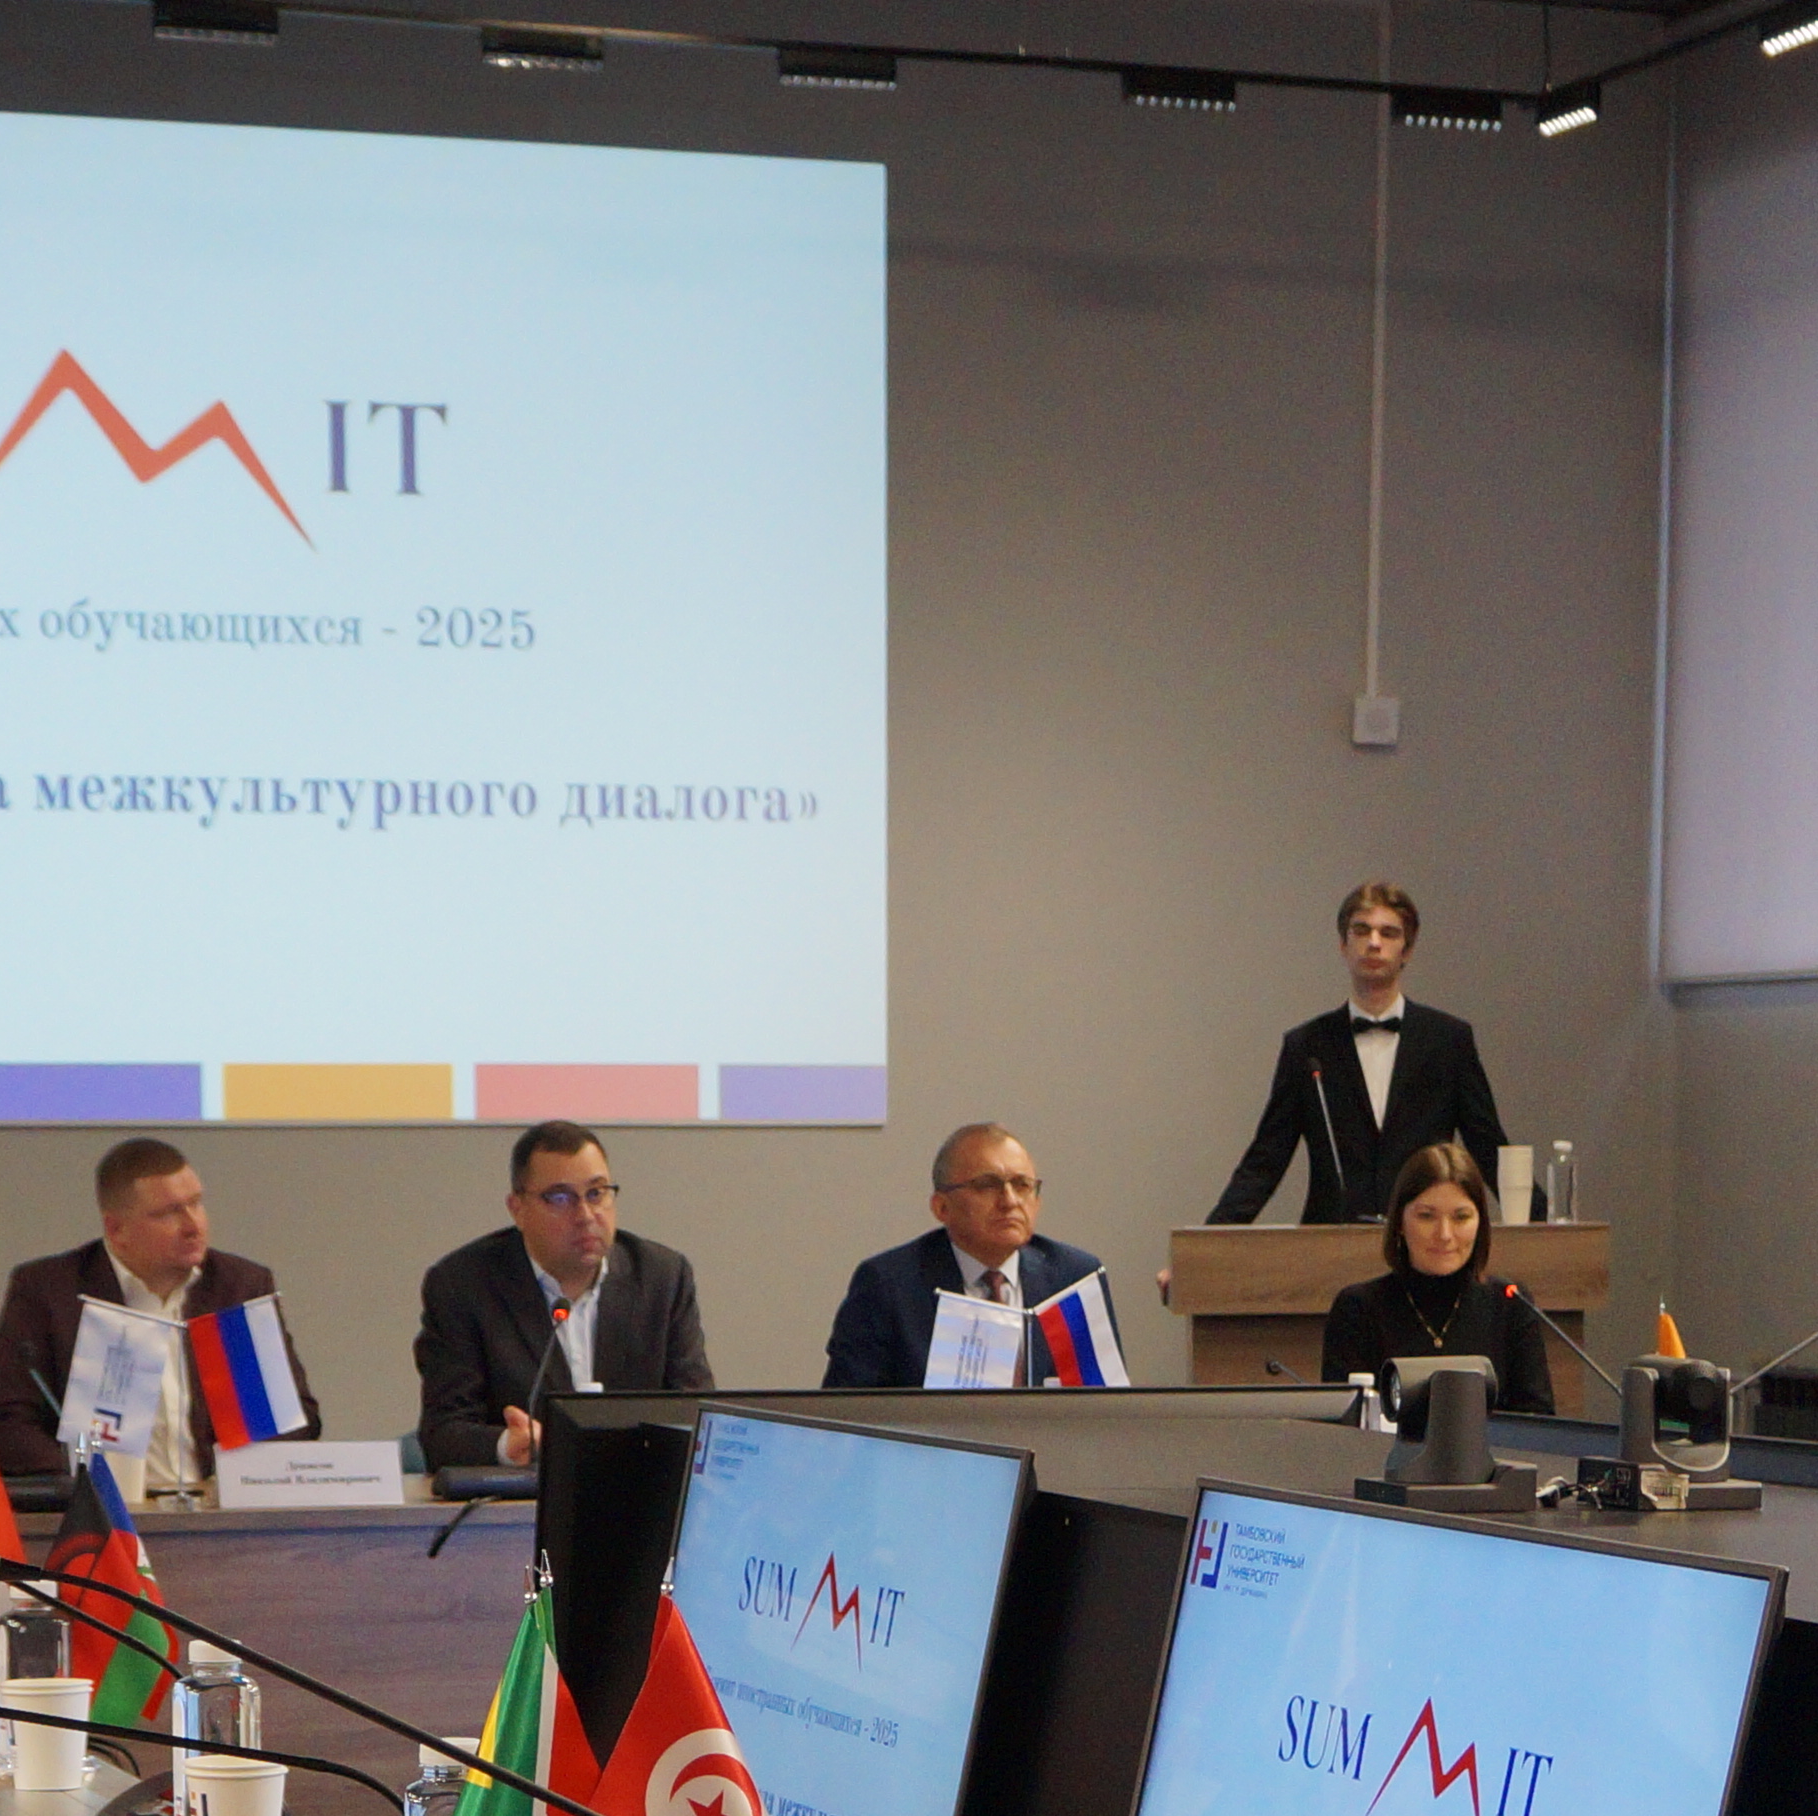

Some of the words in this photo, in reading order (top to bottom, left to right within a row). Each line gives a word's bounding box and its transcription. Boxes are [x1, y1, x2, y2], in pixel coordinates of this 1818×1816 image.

[38, 598, 363, 652] обучающихся
[415, 605, 537, 650] 2025
[32, 773, 538, 832] межкультурного
[558, 781, 819, 828] диалога»
